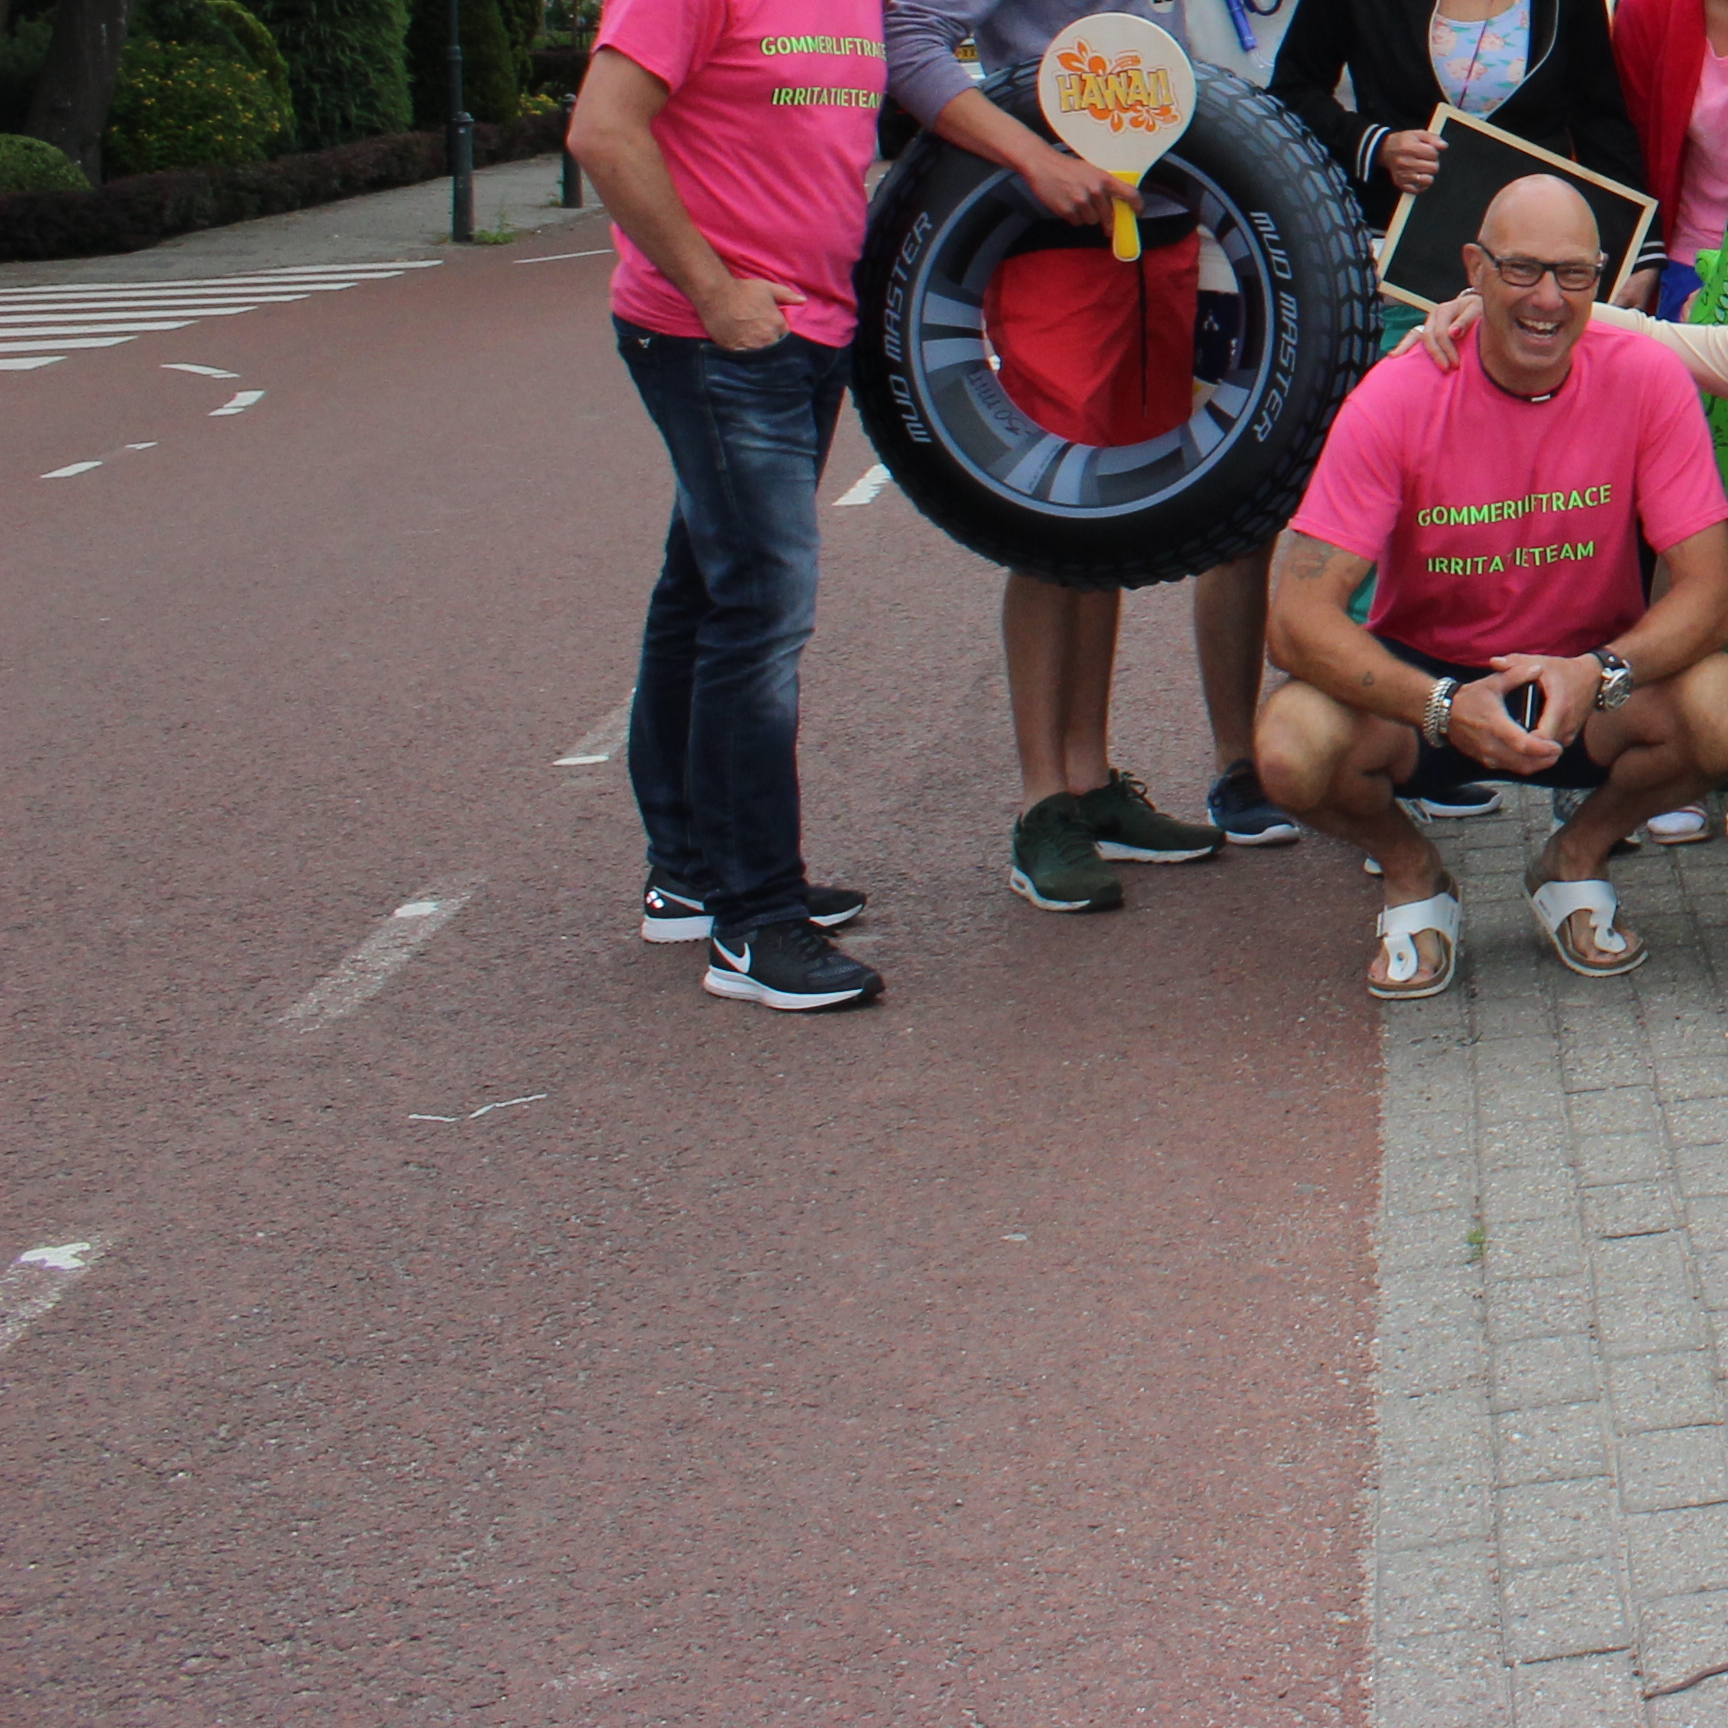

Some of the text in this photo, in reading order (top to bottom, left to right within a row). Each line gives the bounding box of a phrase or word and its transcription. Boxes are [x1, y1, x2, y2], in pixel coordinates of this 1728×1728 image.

[1056, 68, 1174, 112] HAWAII
[884, 211, 933, 444] MUD MASTER
[1250, 211, 1299, 443] MUD MASTER
